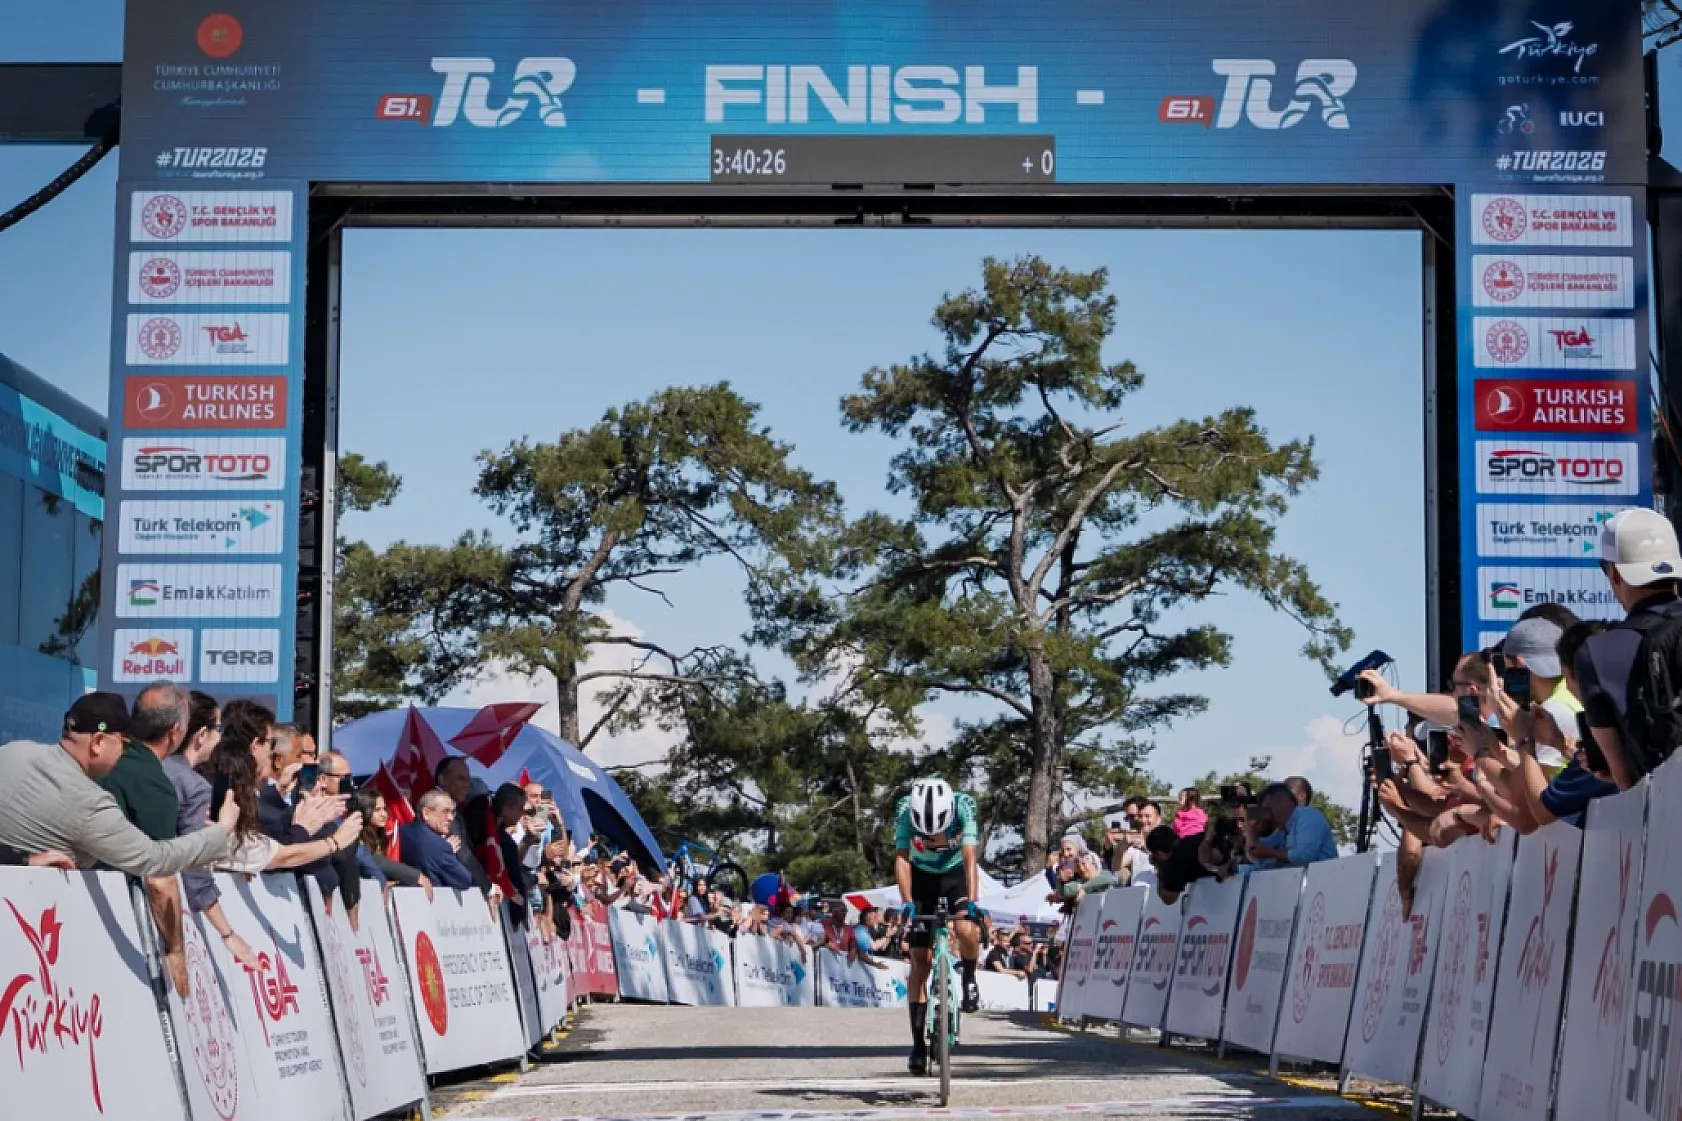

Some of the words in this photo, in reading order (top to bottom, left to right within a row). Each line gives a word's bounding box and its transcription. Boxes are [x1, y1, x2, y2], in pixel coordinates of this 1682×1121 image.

[383, 98, 420, 116] 61.
[430, 56, 577, 127] TUR
[705, 65, 1039, 124] FINISH
[1167, 101, 1203, 119] 61.
[1212, 58, 1357, 130] TUR
[156, 146, 269, 168] #TUR2026
[713, 148, 786, 175] 3:40:26
[1041, 149, 1054, 175] 0
[1496, 151, 1607, 172] #TUR2026
[201, 322, 248, 348] TGA
[1548, 326, 1595, 352] TGA
[184, 384, 275, 401] TURKISH
[1533, 388, 1624, 405] TURKISH
[182, 404, 275, 419] AIRLINES
[1533, 407, 1625, 424] AIRLINES
[133, 517, 168, 532] Türk
[173, 517, 241, 532] Telekom
[1491, 520, 1526, 535] Türk
[1530, 521, 1597, 536] Telekom
